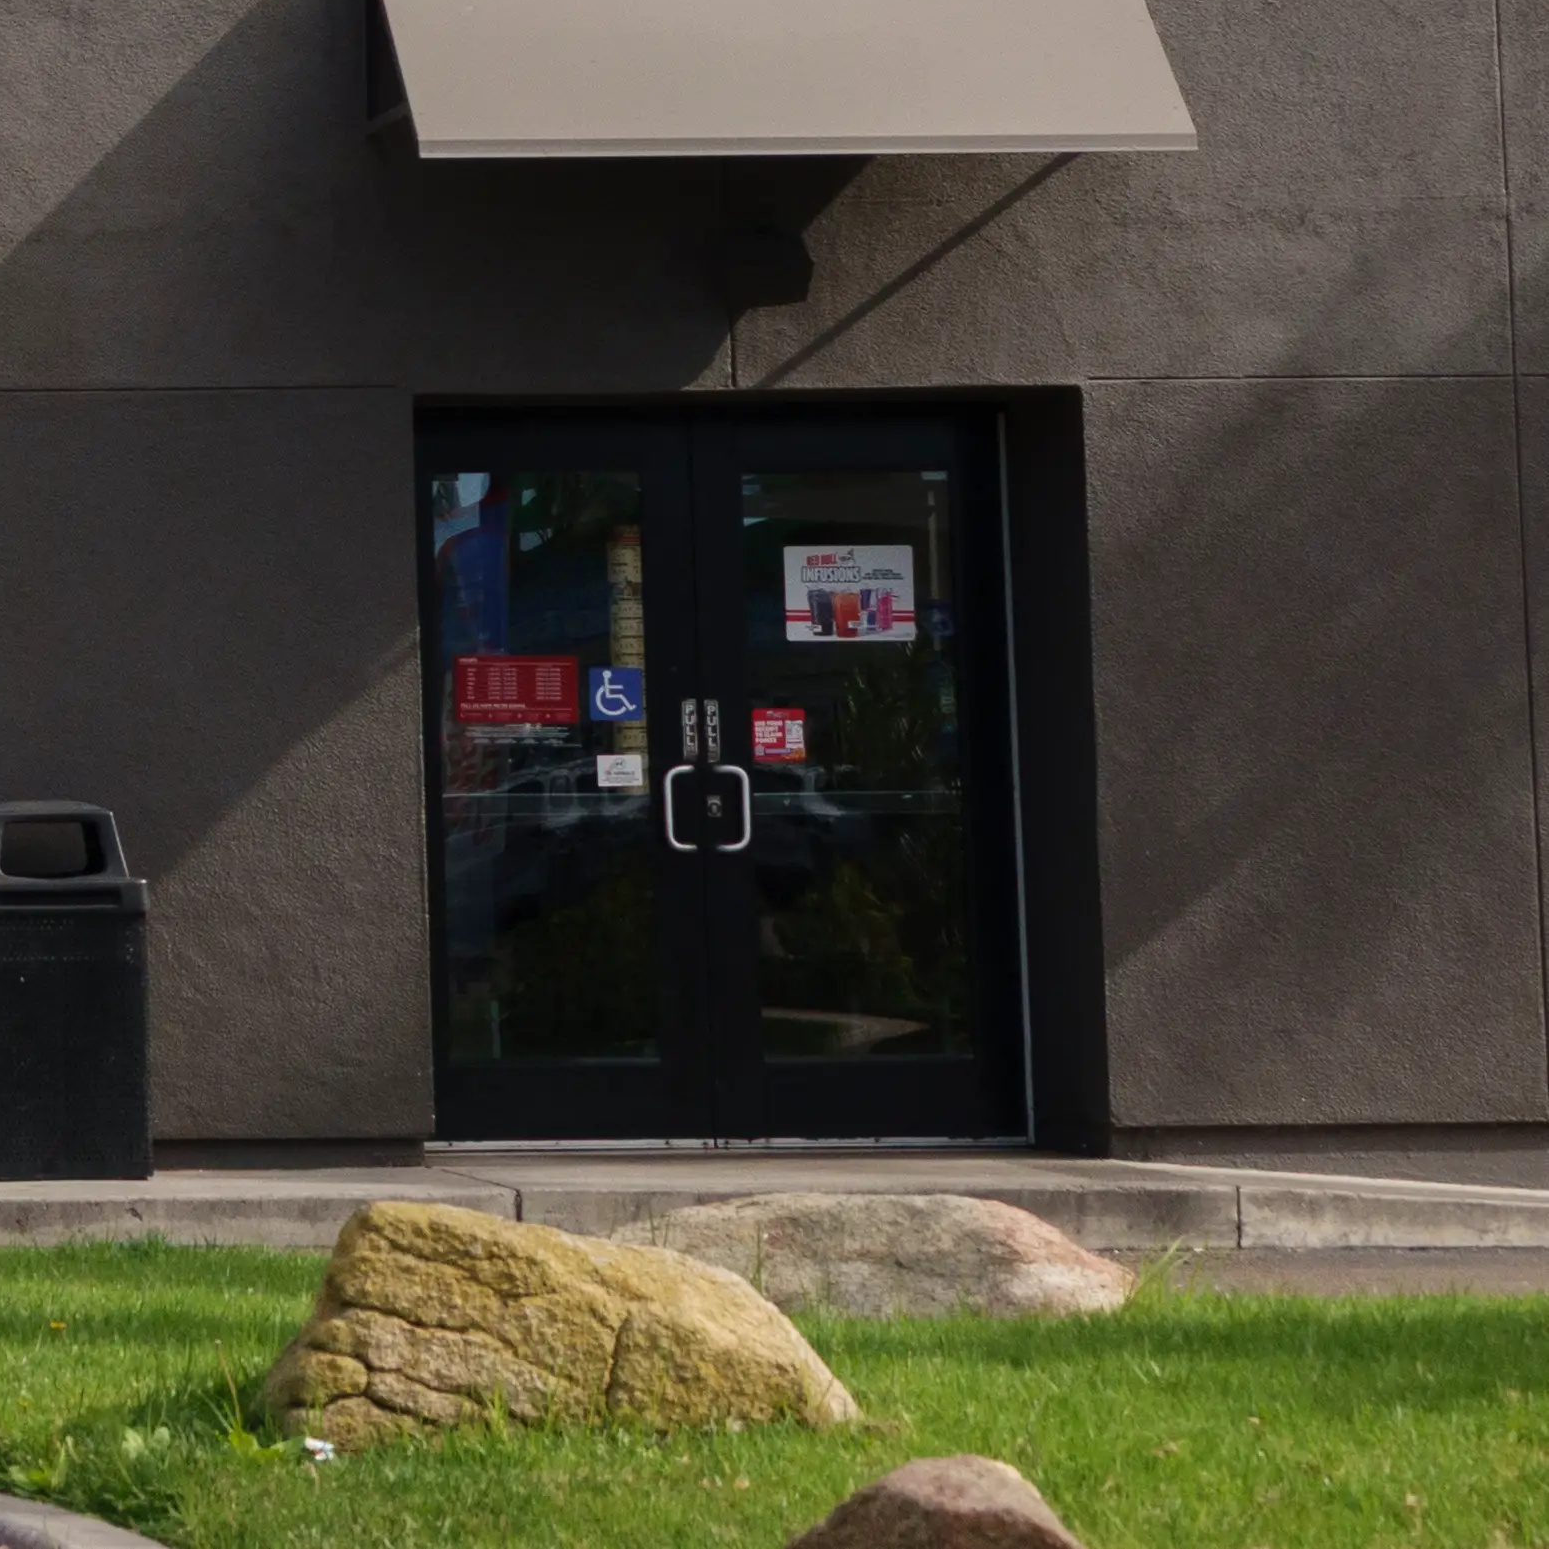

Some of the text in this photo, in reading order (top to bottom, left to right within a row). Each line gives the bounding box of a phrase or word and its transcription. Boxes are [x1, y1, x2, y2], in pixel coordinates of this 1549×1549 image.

[801, 565, 861, 584] INFUSIONS
[685, 704, 695, 746] PULL
[707, 705, 717, 747] PULL
